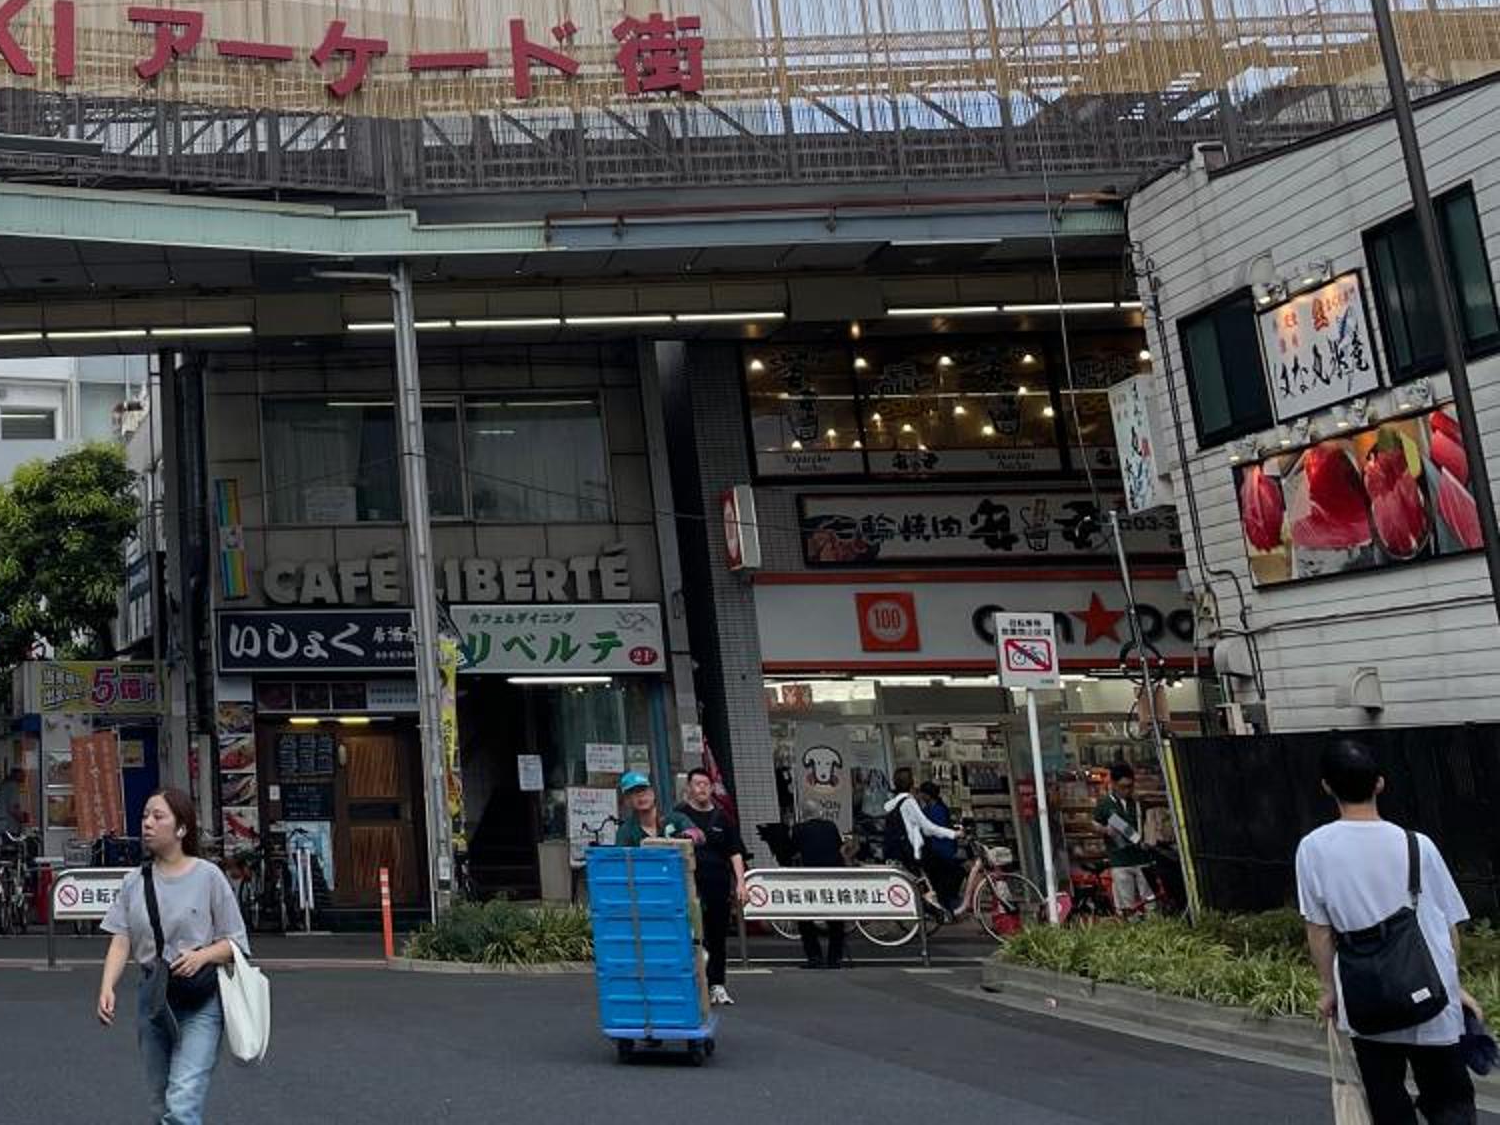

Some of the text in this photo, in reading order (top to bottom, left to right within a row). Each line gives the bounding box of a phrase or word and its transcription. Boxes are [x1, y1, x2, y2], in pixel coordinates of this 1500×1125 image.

[127, 6, 704, 100] アーケード街
[263, 543, 631, 604] CAFÉ IBERTÉ
[873, 607, 902, 631] 100
[971, 604, 1075, 645] Cn
[466, 630, 624, 665] リベルテ
[771, 888, 886, 904] 自転車駐輪禁止
